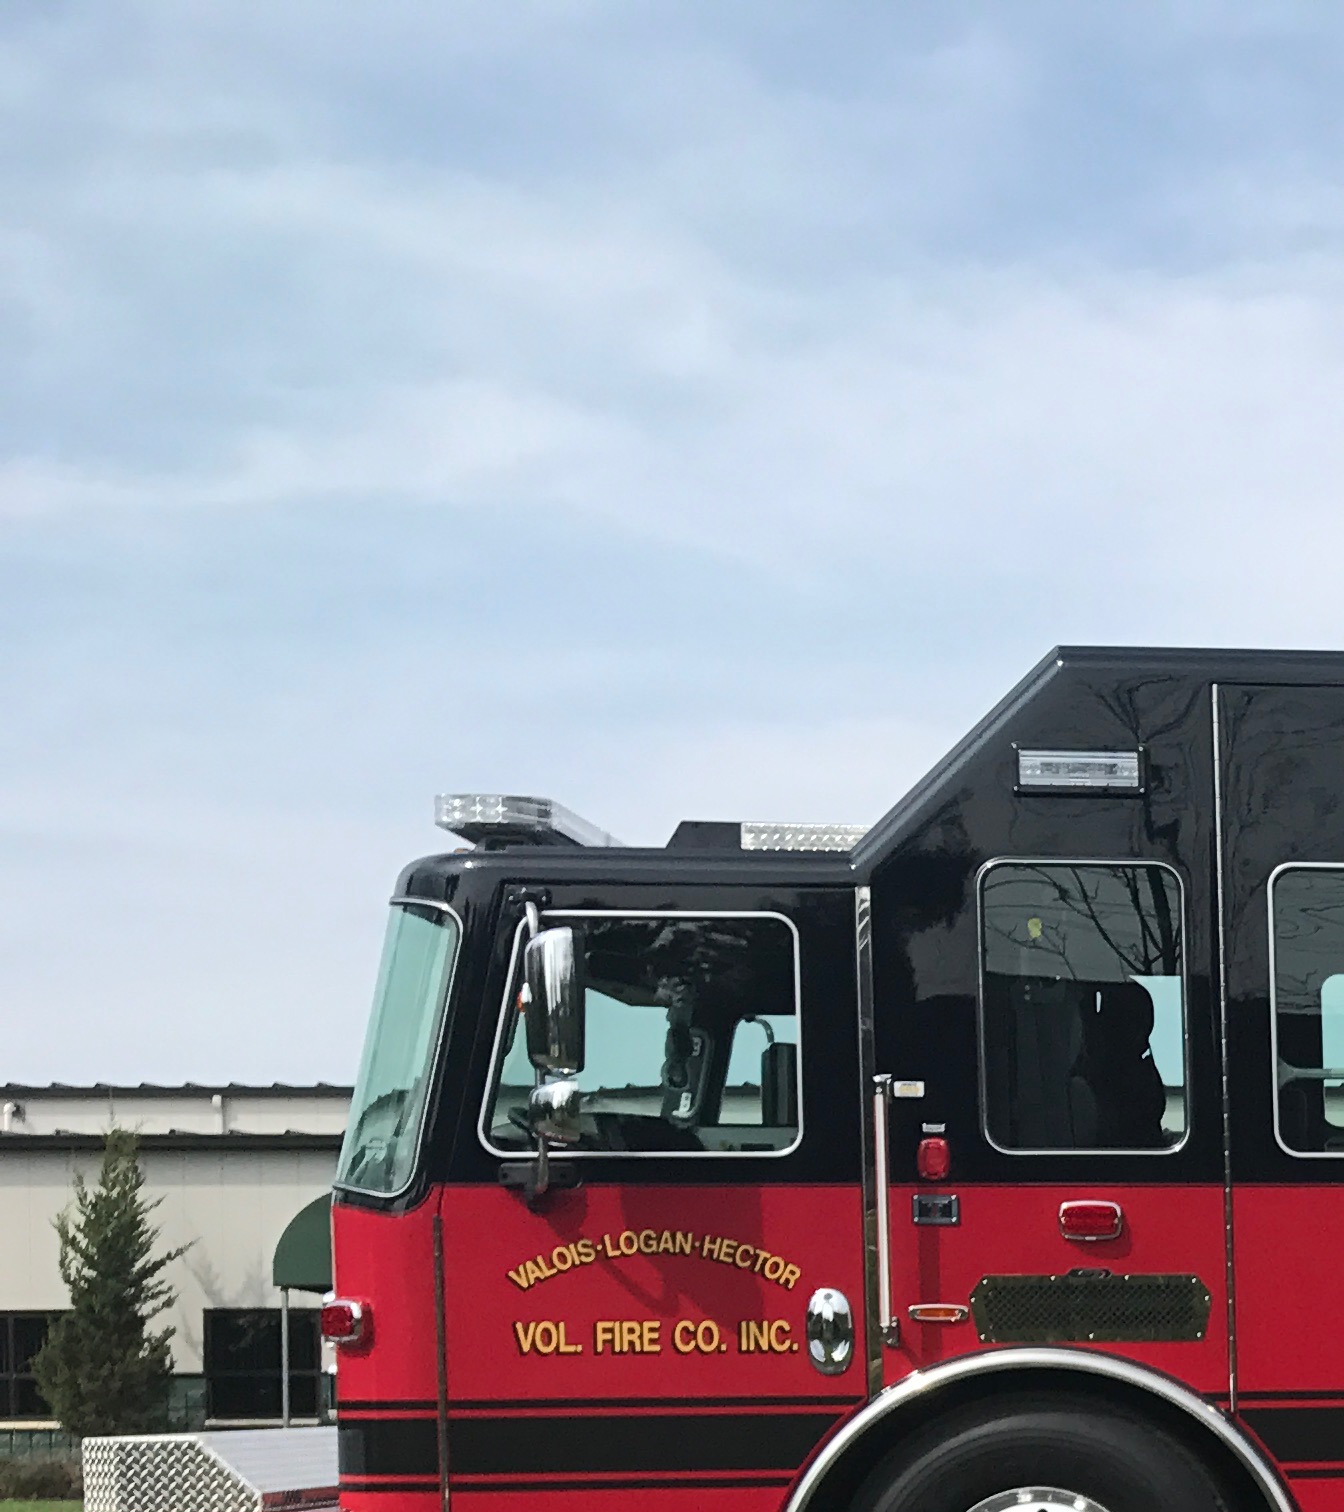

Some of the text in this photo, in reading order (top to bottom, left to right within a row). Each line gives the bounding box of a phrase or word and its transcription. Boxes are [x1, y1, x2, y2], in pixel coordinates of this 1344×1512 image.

[513, 1319, 799, 1356] VOL. FIRE CO. INC.
